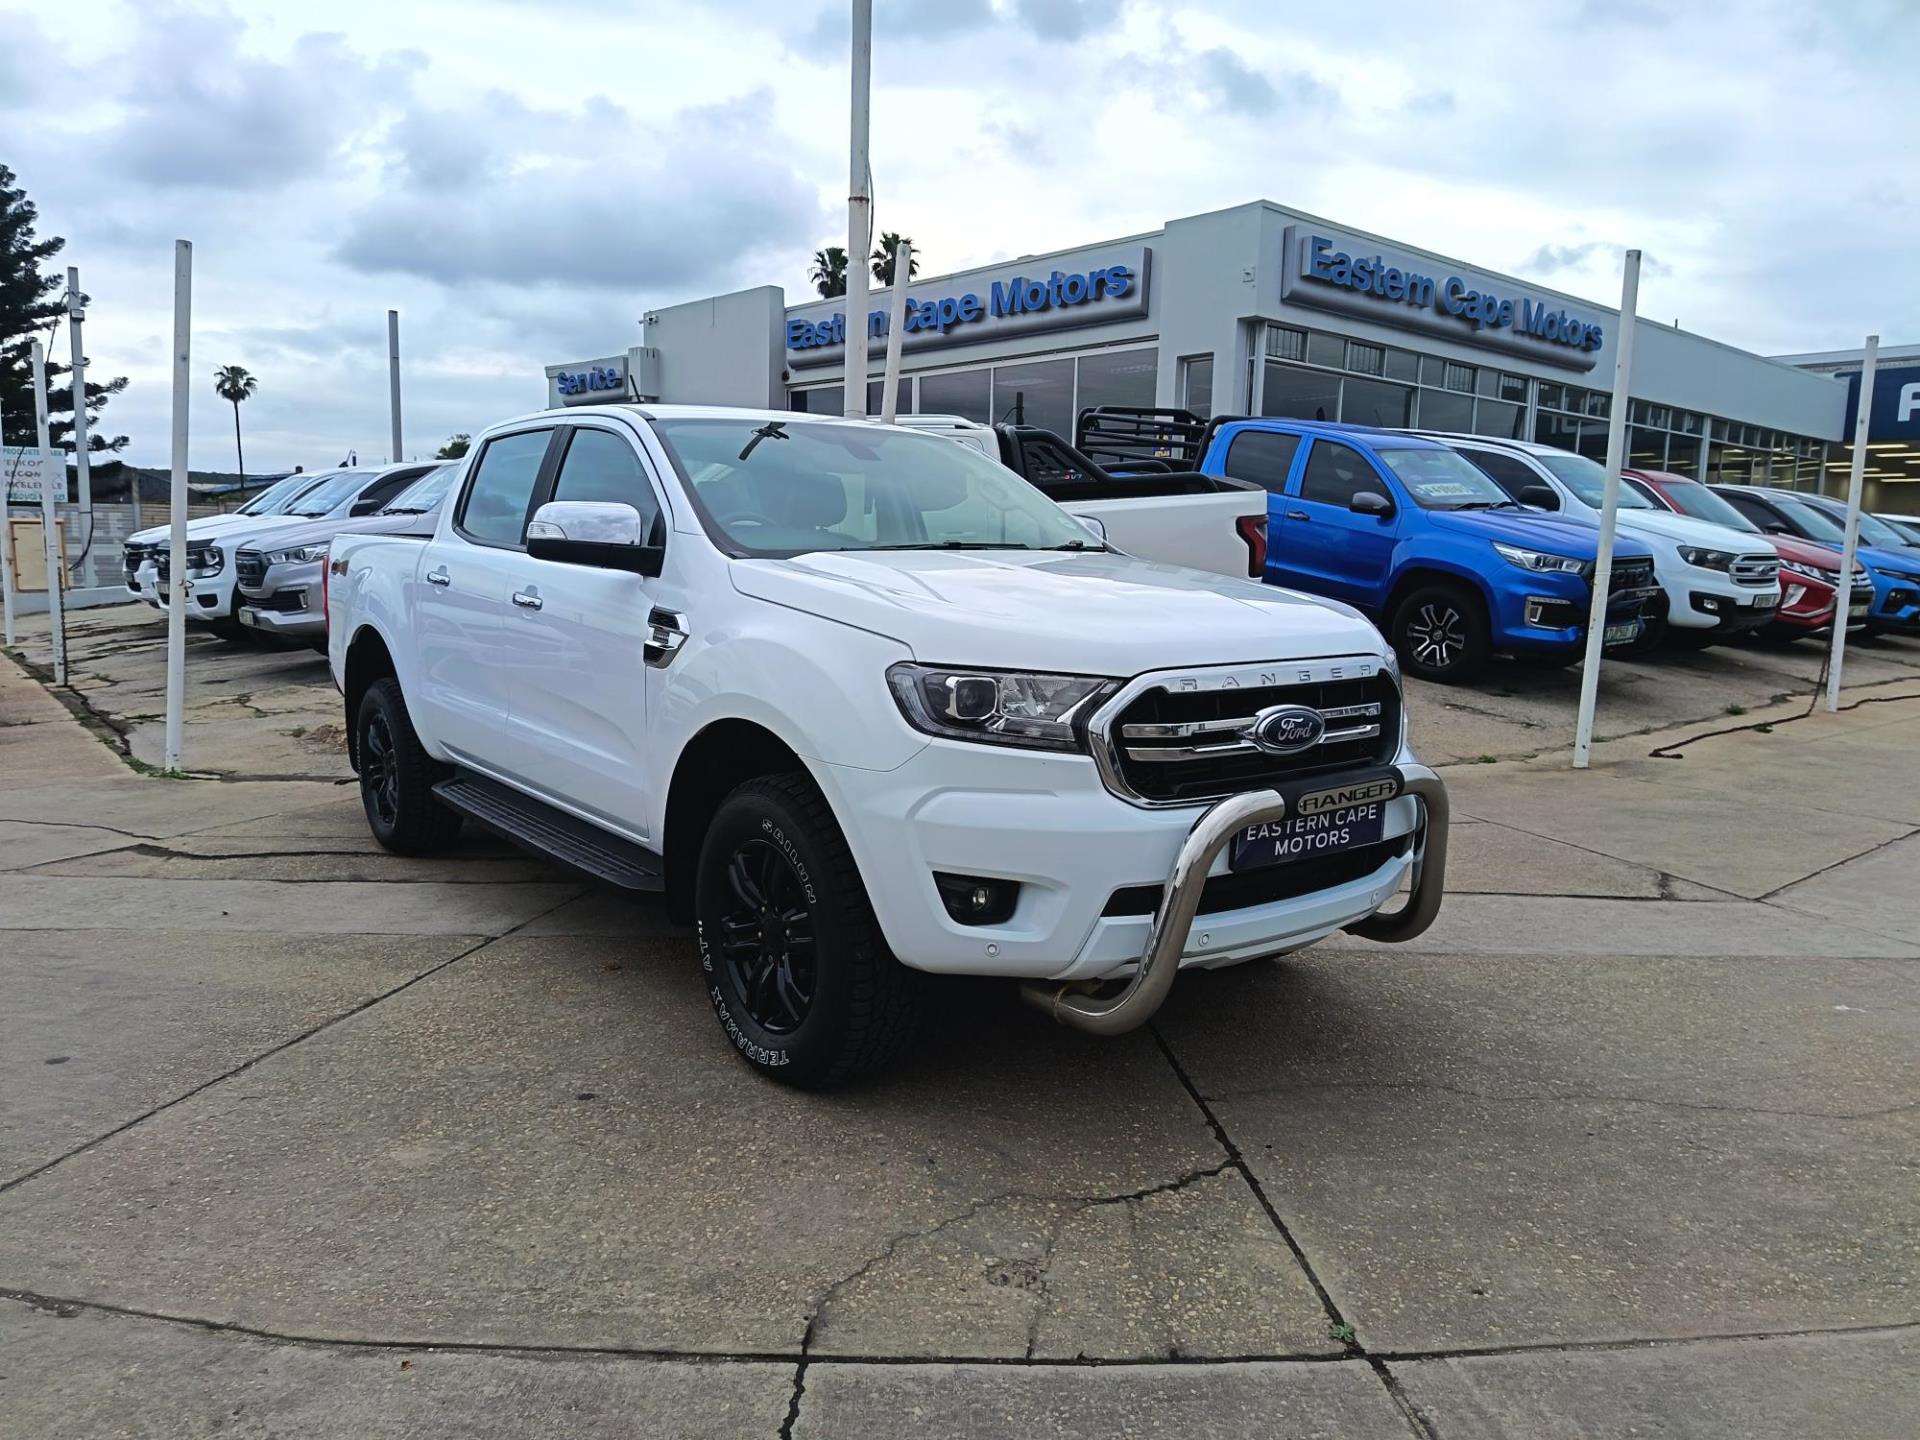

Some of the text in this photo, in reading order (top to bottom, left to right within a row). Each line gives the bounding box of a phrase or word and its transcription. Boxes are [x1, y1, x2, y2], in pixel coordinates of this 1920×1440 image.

[1307, 235, 1602, 350] Eastern Cape Motors
[787, 265, 1129, 349] Eastn Cape Motors
[558, 367, 617, 394] Service
[1179, 664, 1371, 691] RANGER
[1278, 717, 1312, 741] Ford
[1303, 782, 1393, 811] RANGER
[1247, 804, 1377, 840] EASTERN CAPE
[1274, 828, 1350, 856] MOTORS
